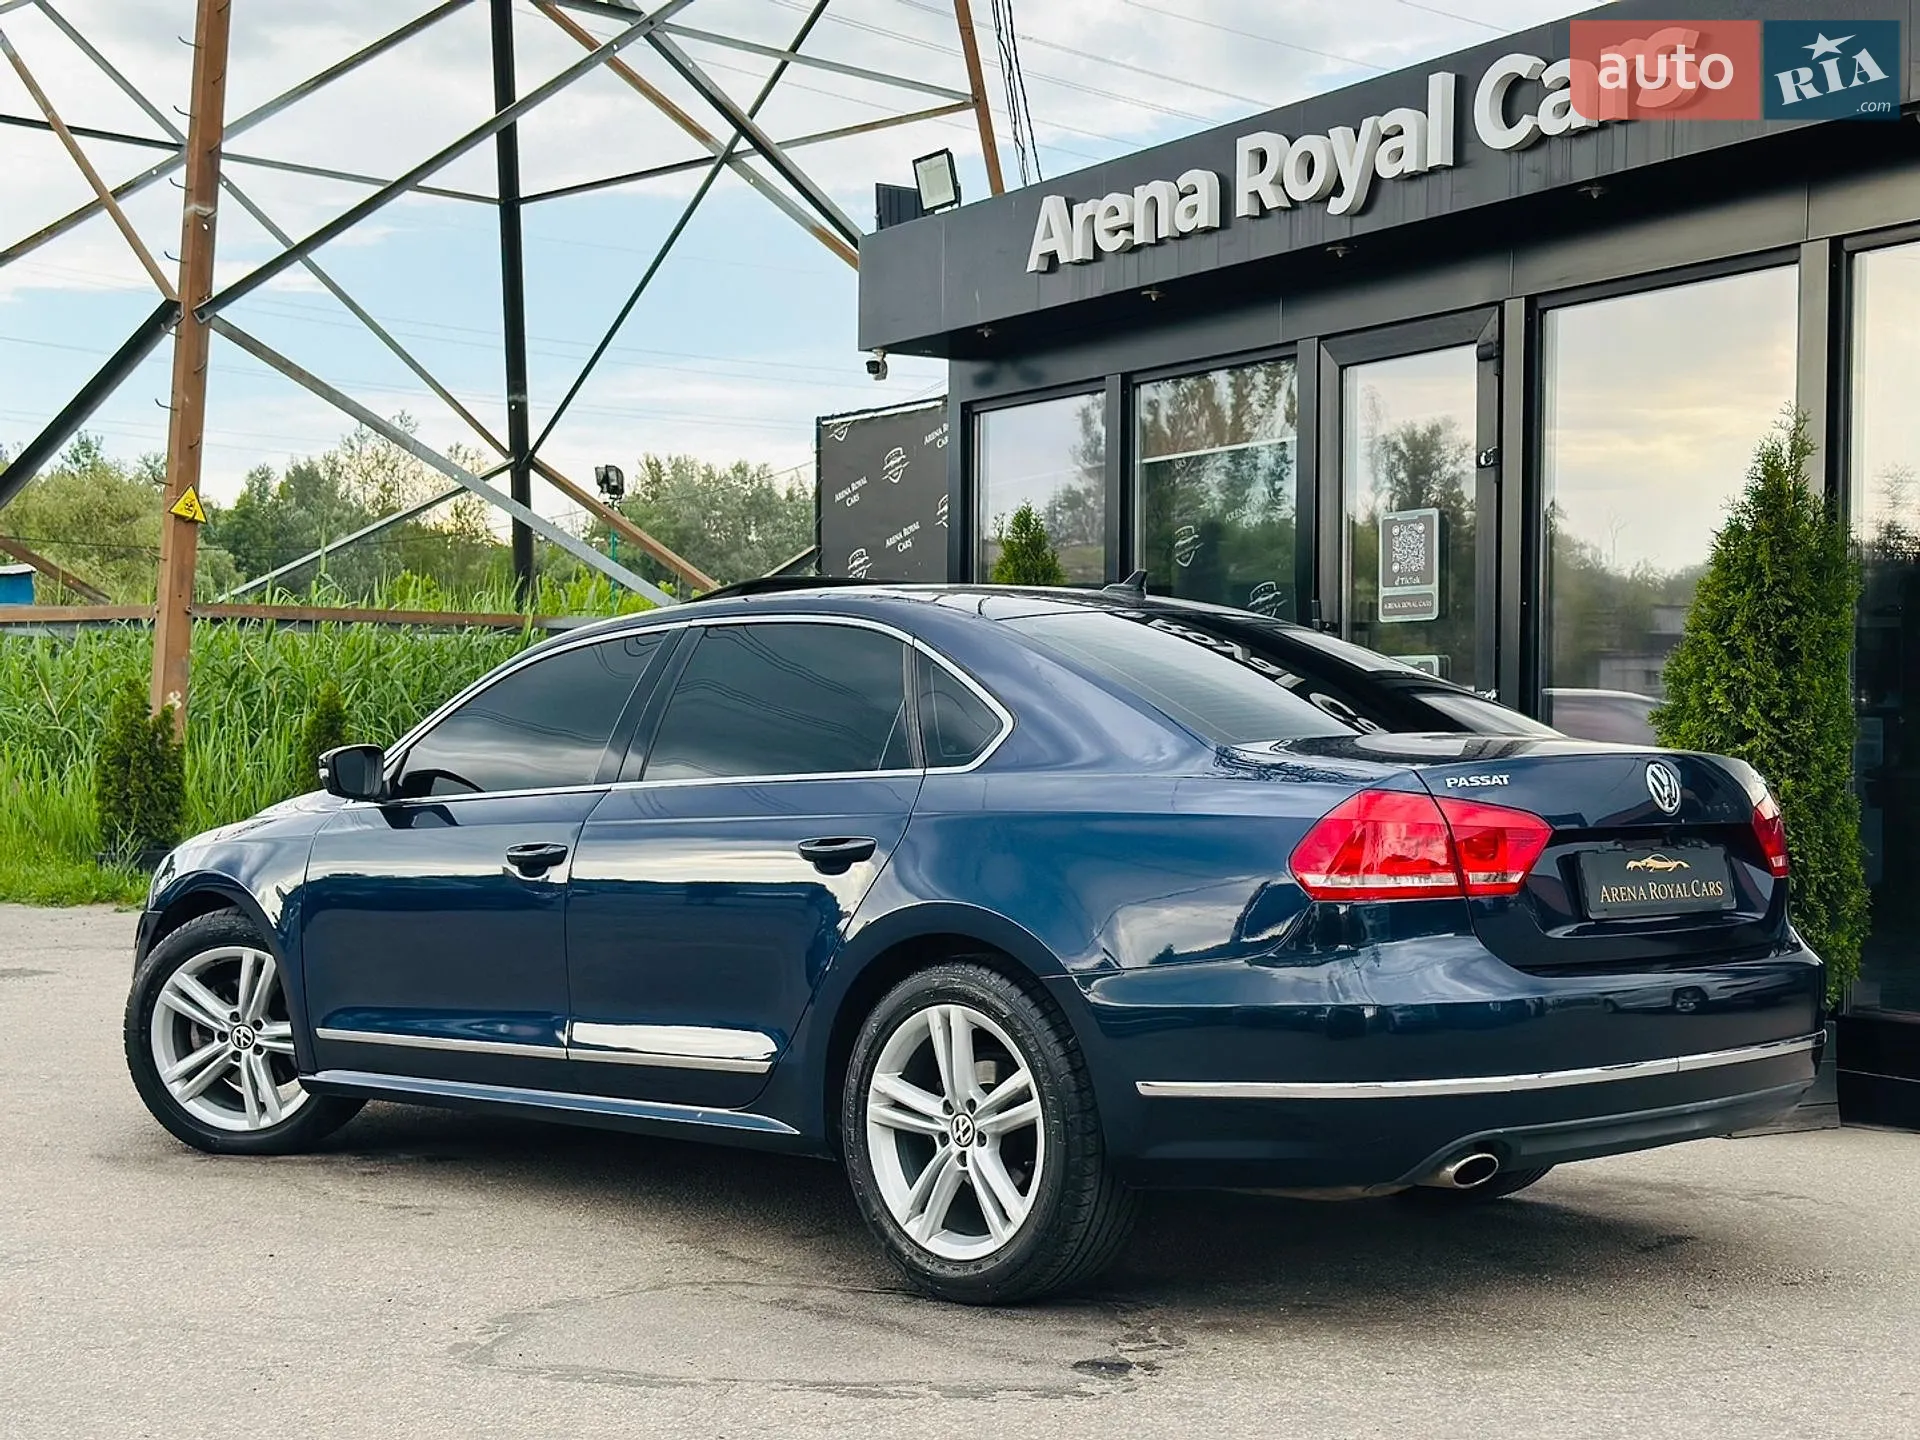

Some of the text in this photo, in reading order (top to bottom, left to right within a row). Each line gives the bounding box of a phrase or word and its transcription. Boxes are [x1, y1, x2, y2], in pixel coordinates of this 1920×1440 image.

[1027, 27, 1700, 273] Arena Royal Cars
[1446, 774, 1510, 788] PASSAT
